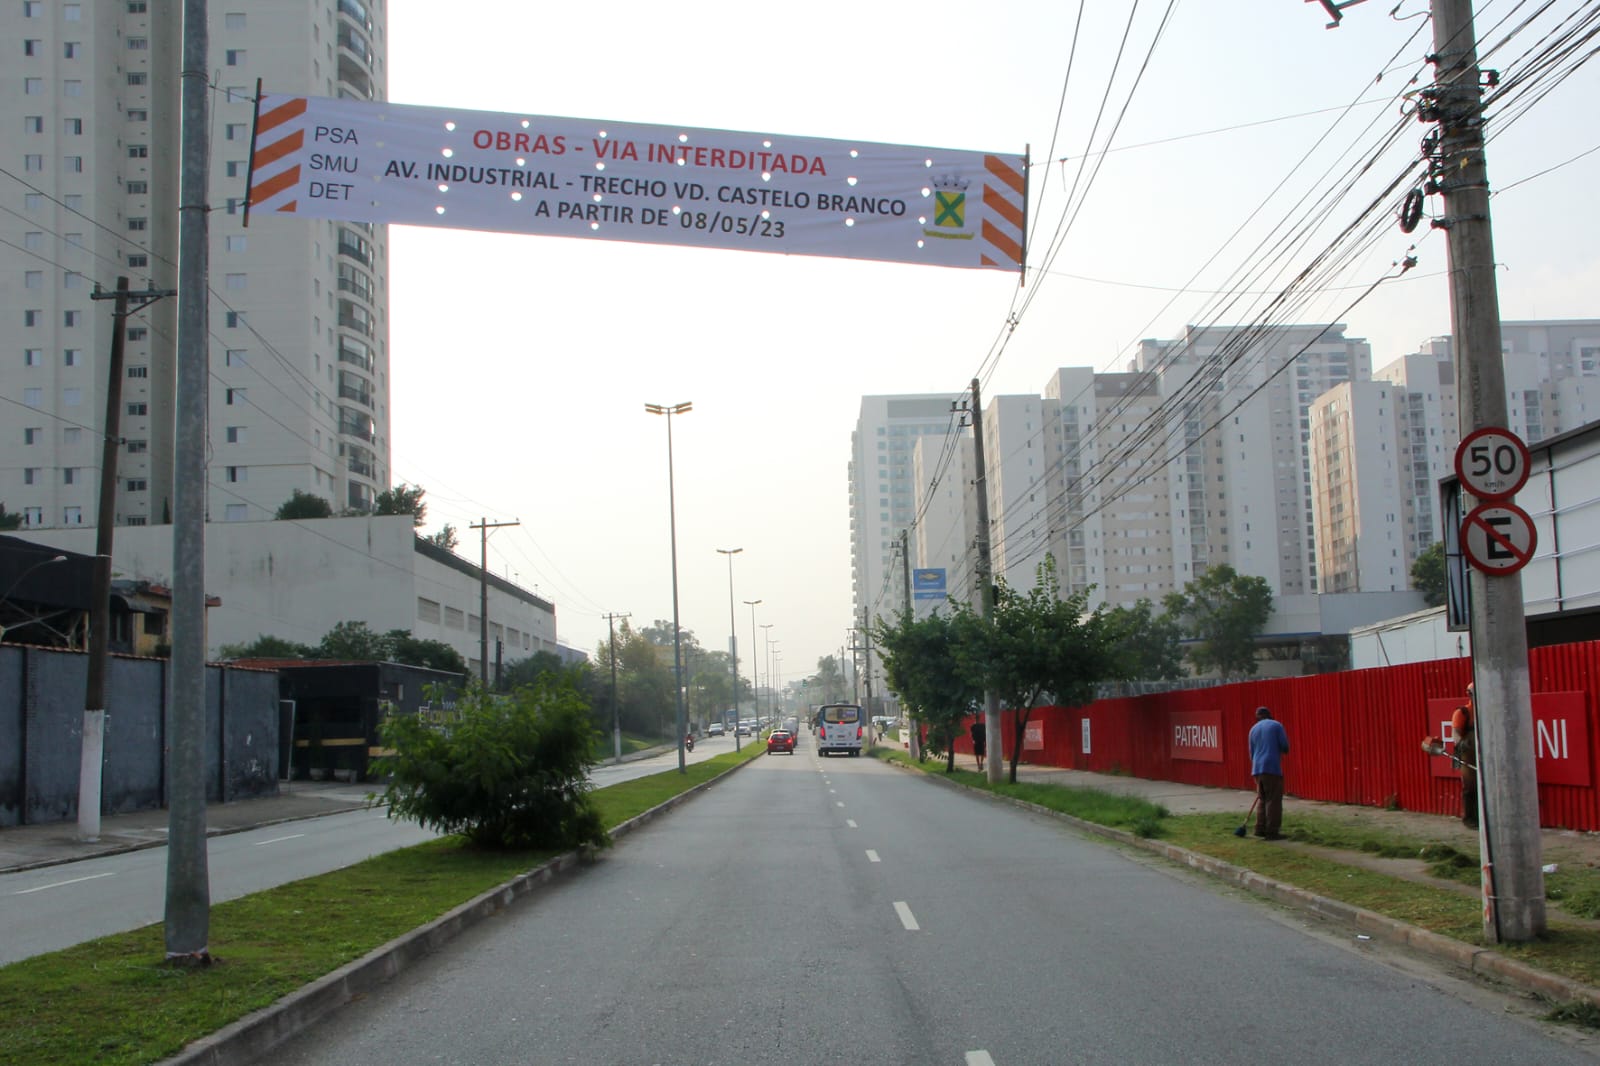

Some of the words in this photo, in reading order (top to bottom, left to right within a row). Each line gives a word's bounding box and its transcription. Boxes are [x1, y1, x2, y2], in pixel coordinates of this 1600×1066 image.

[314, 125, 359, 145] PSA
[309, 153, 359, 173] SMU
[473, 129, 566, 155] OBRAS
[592, 138, 639, 161] VIA
[647, 143, 827, 177] INTERDITADA
[309, 181, 355, 201] DET
[384, 160, 419, 179] AV.
[427, 162, 559, 190] INDUSTRIAL
[580, 174, 667, 198] TRECHO
[674, 182, 709, 201] VD.
[717, 185, 810, 209] CASTELO
[817, 193, 906, 216] BRANCO
[535, 200, 550, 218] A
[557, 201, 634, 224] PARTIR
[641, 208, 669, 226] DE
[680, 211, 785, 238] 08/05/23
[1470, 444, 1516, 476] 50
[1485, 516, 1514, 560] E
[1174, 725, 1218, 748] PATRIANI
